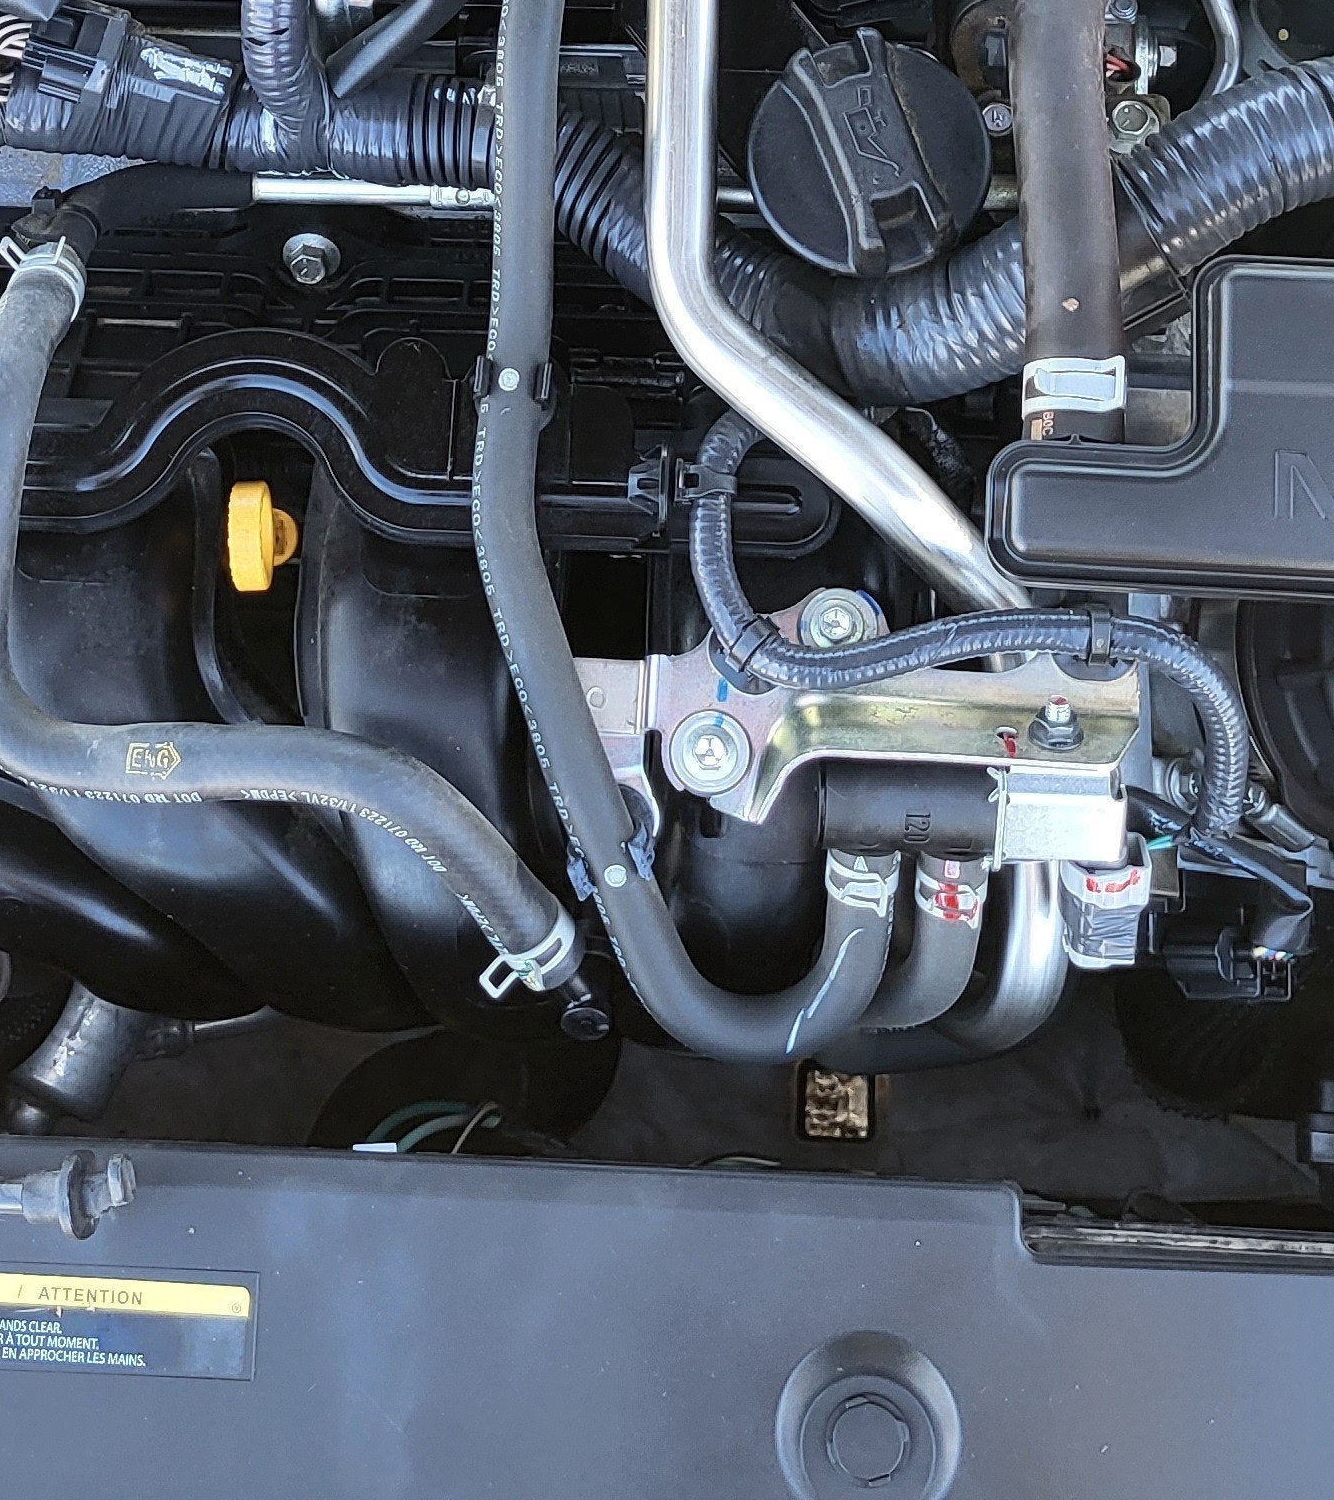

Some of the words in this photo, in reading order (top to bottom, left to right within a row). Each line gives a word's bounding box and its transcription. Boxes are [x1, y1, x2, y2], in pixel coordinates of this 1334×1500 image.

[84, 789, 140, 803] 071223
[171, 789, 203, 804] DOT
[357, 806, 410, 838] 071223
[903, 812, 931, 844] 120
[420, 848, 448, 876] DOT
[38, 1285, 142, 1305] ATTENTION
[28, 1320, 62, 1334] CLEAR.
[7, 1331, 15, 1345] À
[15, 1334, 45, 1346] TOUT
[47, 1335, 99, 1350] MOMENT.
[2, 1348, 17, 1358] EN
[19, 1348, 85, 1363] APPROCHER
[87, 1352, 105, 1363] LES
[107, 1353, 146, 1367] MAINS.
